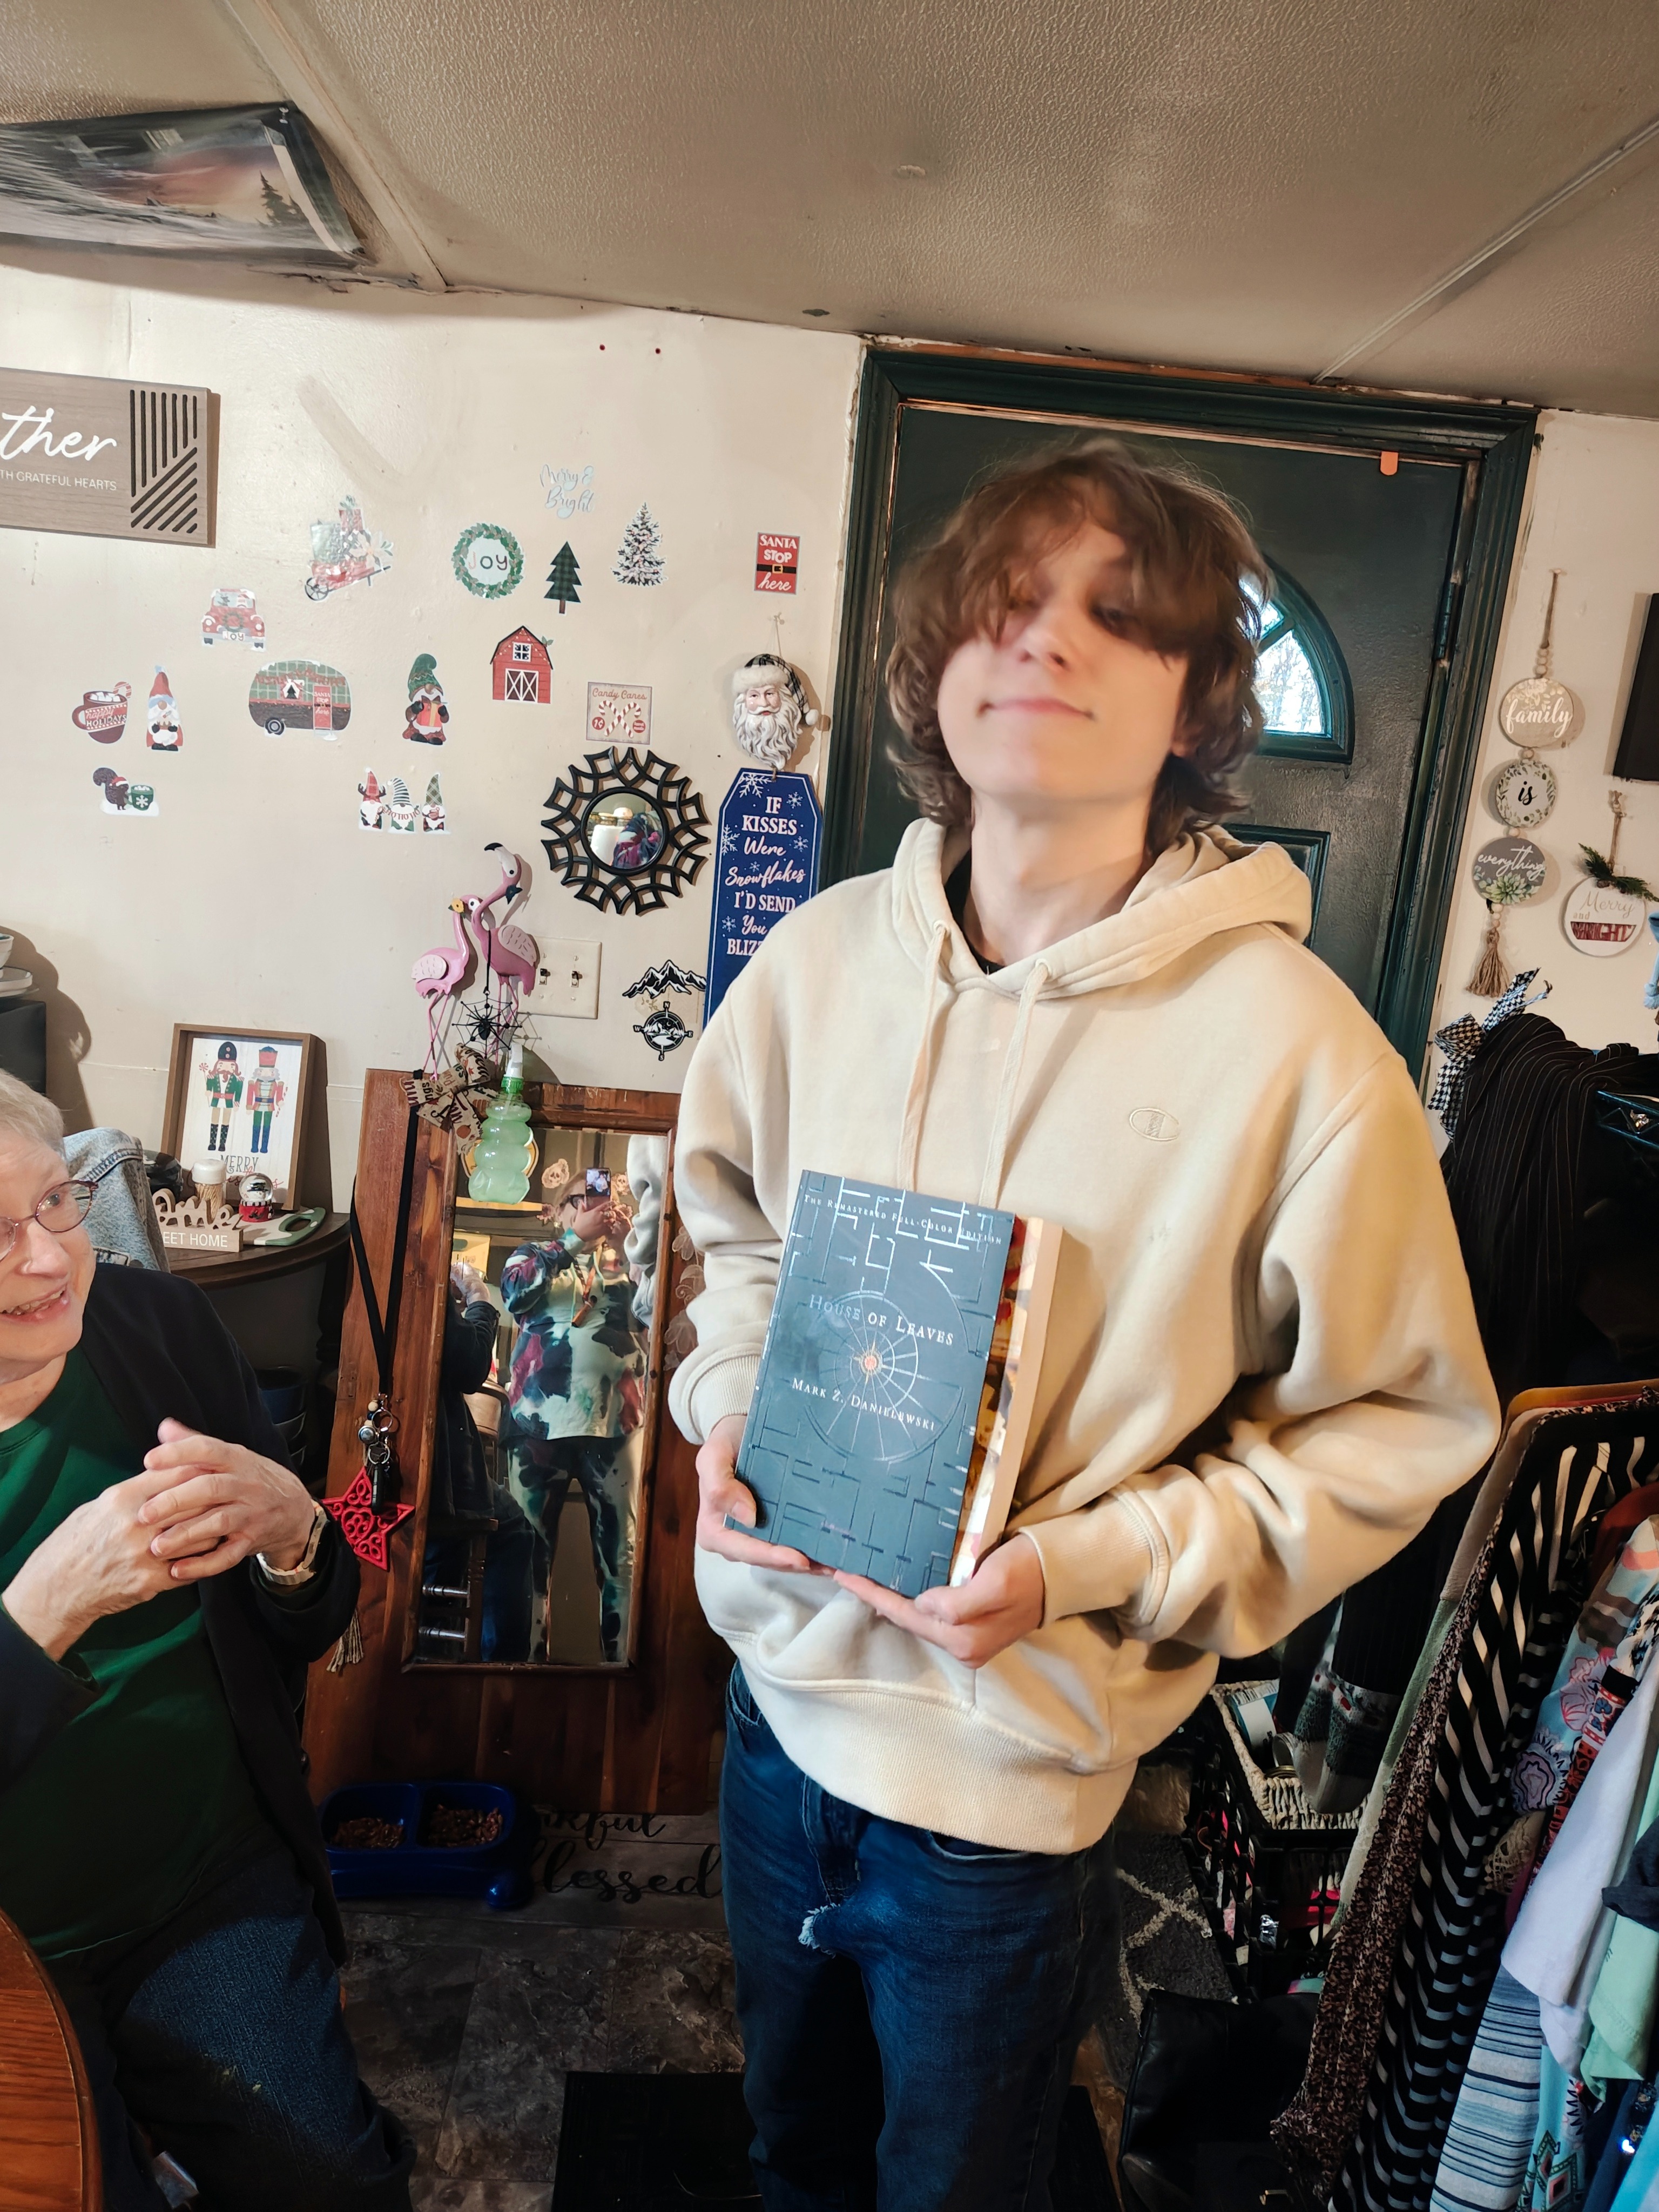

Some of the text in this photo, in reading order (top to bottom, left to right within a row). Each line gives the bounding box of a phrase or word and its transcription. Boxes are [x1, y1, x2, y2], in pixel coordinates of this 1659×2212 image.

[0, 405, 117, 461] ther
[0, 469, 117, 491] TH GRATEFUL HEARTS
[540, 464, 578, 491] Merry
[544, 485, 595, 519] Bright
[759, 535, 797, 549] SANTA
[764, 549, 792, 563] STOP
[758, 571, 792, 591] here
[592, 687, 648, 701] Candy Canes
[85, 707, 114, 720] happy
[86, 714, 127, 727] HOLIDAYS
[1506, 697, 1574, 738] family
[1518, 781, 1538, 806] is
[765, 796, 783, 814] IF
[741, 815, 798, 835] KISSES
[744, 835, 787, 857] Were
[725, 860, 806, 888] Snowflakes
[1478, 845, 1546, 882] everything
[734, 890, 796, 913] I'D SEND
[1579, 891, 1635, 919] Merry
[741, 914, 768, 935] You
[1573, 911, 1591, 920] and
[220, 1155, 259, 1174] MERRY
[163, 1232, 228, 1248] EET HOME
[809, 1294, 954, 1346] HOUSE OF LEAVES
[792, 1377, 827, 1399] MARK
[851, 1394, 935, 1432] DANIELEWSKI
[532, 1839, 723, 1904] lessed
